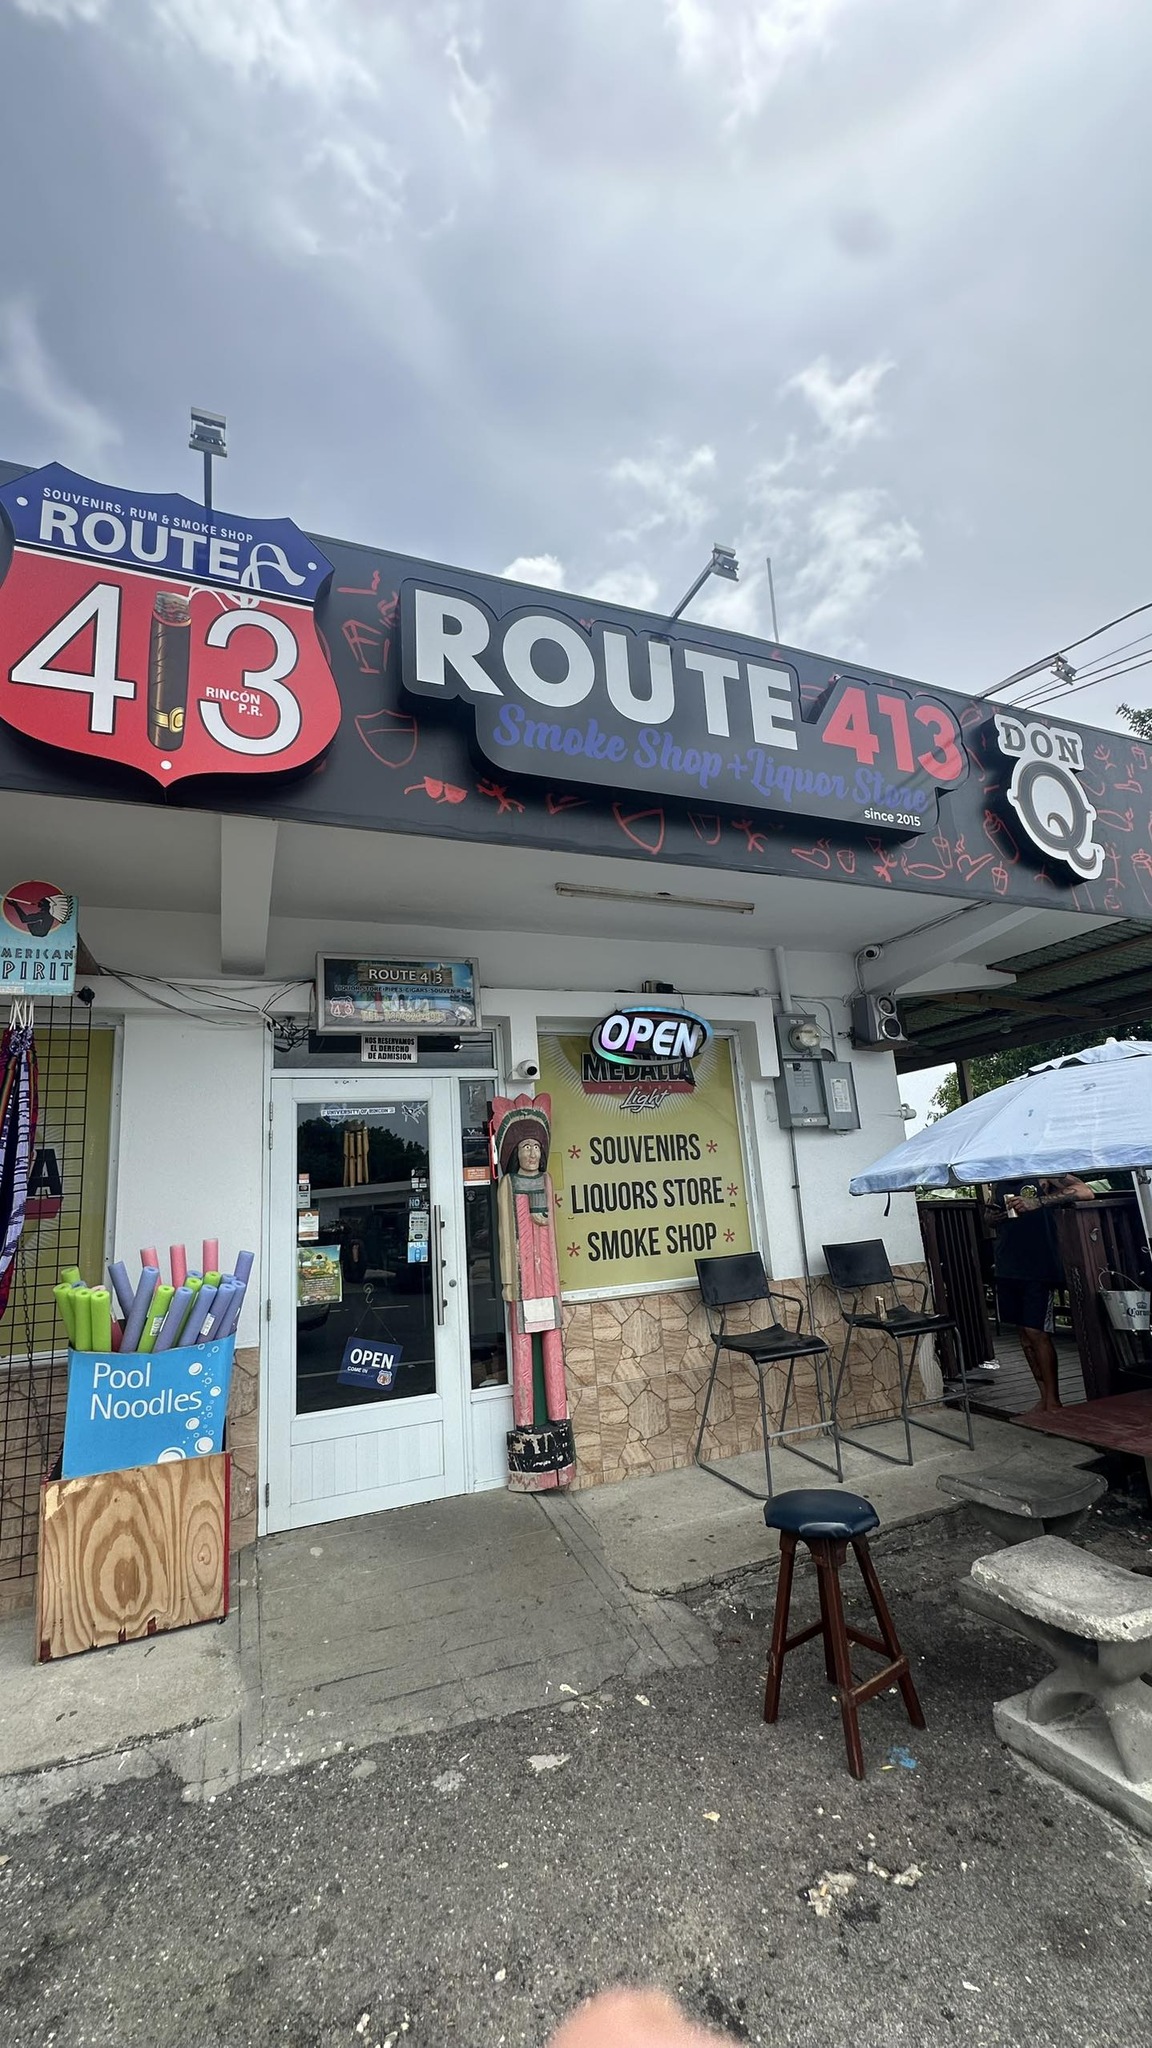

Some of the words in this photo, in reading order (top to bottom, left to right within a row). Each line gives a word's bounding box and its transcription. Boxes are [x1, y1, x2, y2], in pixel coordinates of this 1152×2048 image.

[43, 487, 126, 516] SOUVENIRS,
[129, 507, 157, 522] RUM
[162, 513, 170, 524] &
[173, 517, 217, 536] SMOKE
[221, 528, 253, 543] SHOP
[39, 499, 240, 580] ROUTE
[205, 686, 260, 704] RINCÓN
[415, 589, 798, 750] ROUTE
[822, 687, 963, 782] 413
[238, 704, 264, 718] P.R.
[999, 719, 1079, 765] DON
[493, 703, 630, 762] Smoke
[633, 728, 722, 789] Shop
[853, 767, 929, 813] Store
[864, 808, 894, 823] since
[896, 812, 921, 827] 2015
[1014, 760, 1105, 872] Q
[0, 947, 74, 960] MERICAN
[0, 960, 74, 981] PIRIT
[369, 969, 417, 981] ROUTE
[378, 1037, 415, 1045] RESERVAMOS
[378, 1045, 410, 1053] DERECHO
[601, 1014, 701, 1058] OPEN
[620, 1086, 671, 1113] Light
[589, 1133, 701, 1165] SOUVENIRS
[571, 1180, 657, 1214] LIQUORS
[663, 1176, 724, 1208] STORE
[587, 1227, 661, 1262] SMOKE
[666, 1222, 717, 1254] SHOP
[350, 1348, 394, 1370] OPEN
[93, 1362, 151, 1389] Pool
[90, 1389, 202, 1420] Noodles
